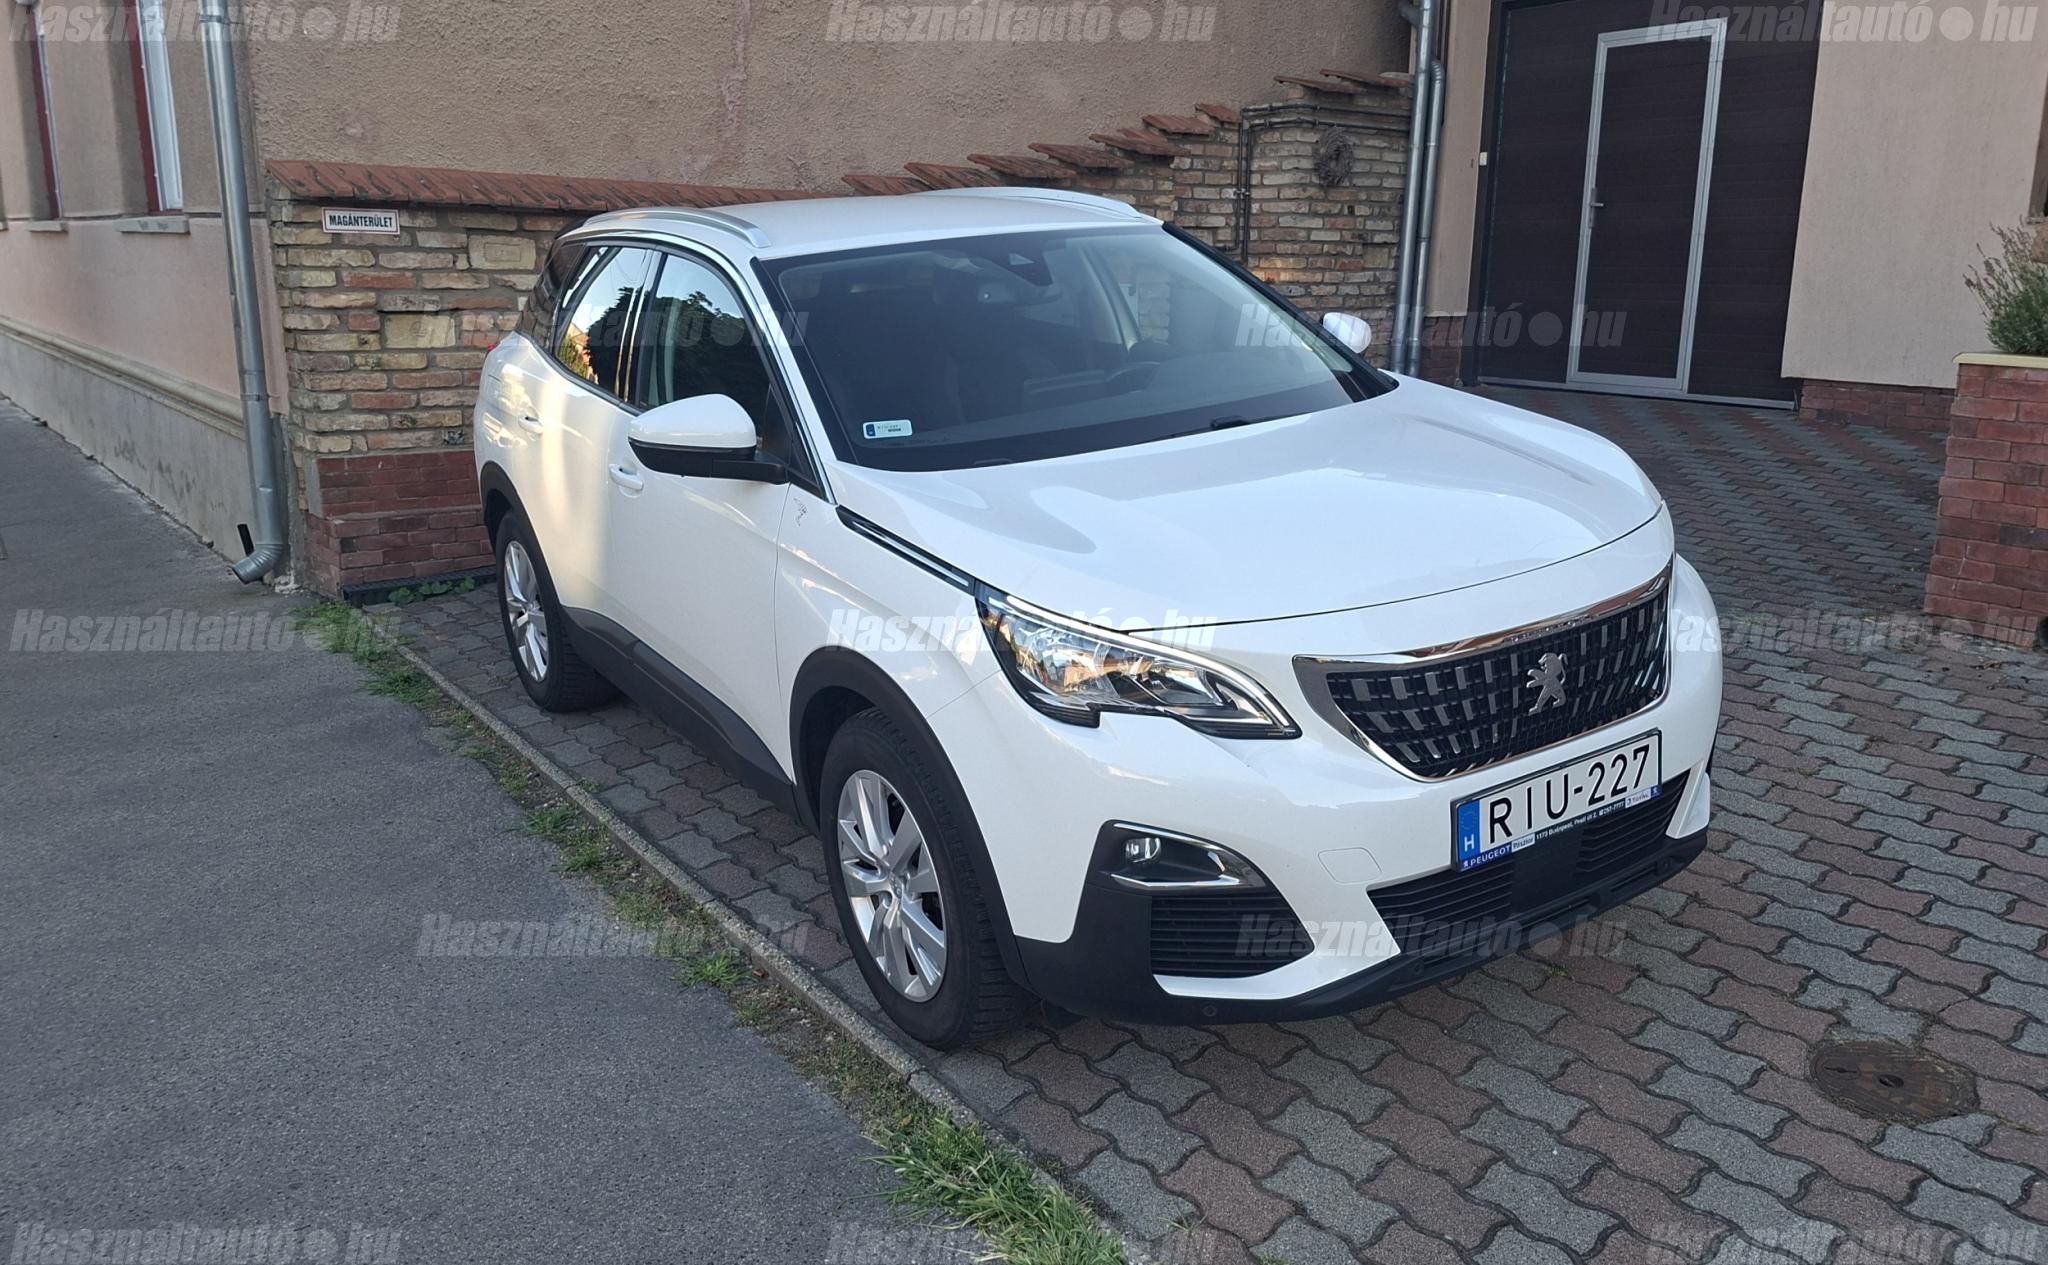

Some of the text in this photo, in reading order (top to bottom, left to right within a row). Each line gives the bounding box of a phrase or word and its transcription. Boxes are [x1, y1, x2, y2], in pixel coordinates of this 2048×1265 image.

[329, 213, 393, 228] MAGÁNTERÜLET
[1489, 743, 1650, 844] RIU-227
[1464, 834, 1475, 852] H
[1470, 844, 1511, 866] PEUGEOT
